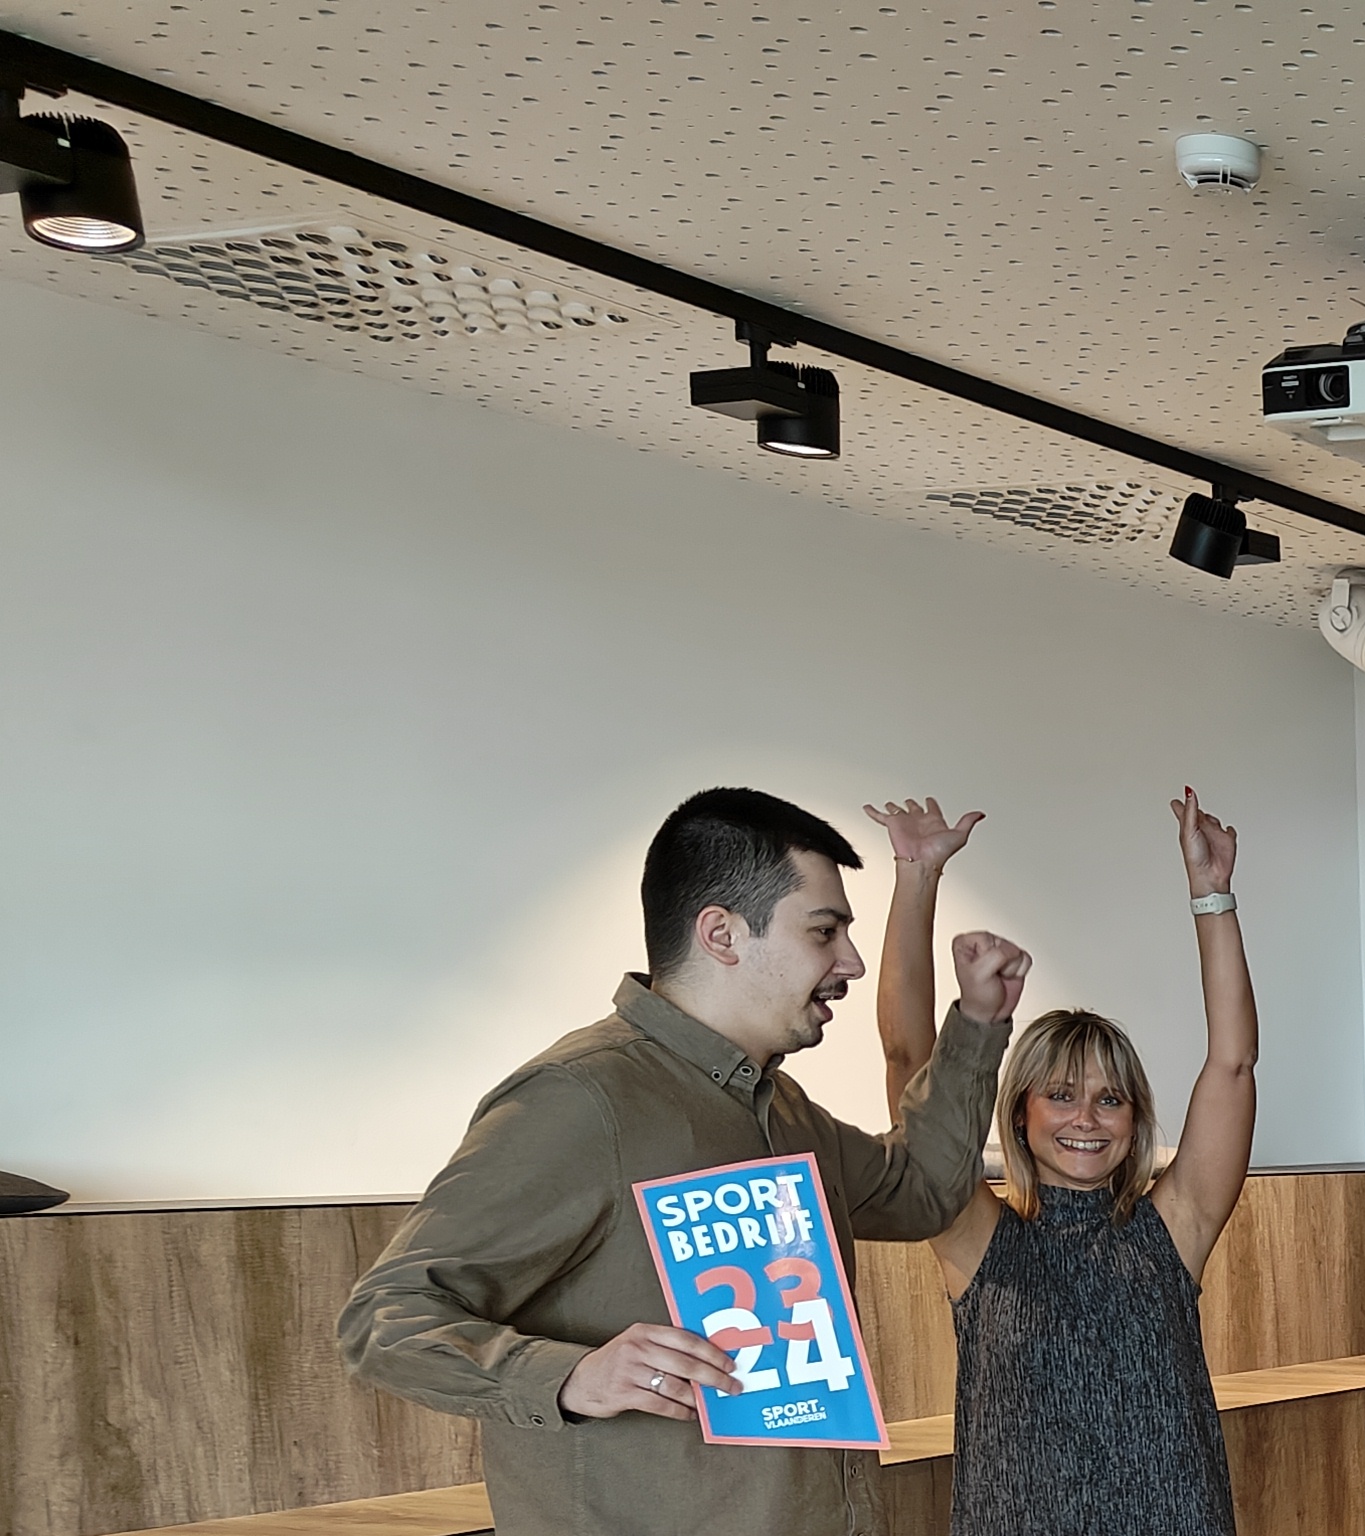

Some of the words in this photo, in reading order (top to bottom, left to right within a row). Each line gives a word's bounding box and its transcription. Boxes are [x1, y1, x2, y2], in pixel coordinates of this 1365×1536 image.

[656, 1173, 804, 1227] SPORT
[667, 1209, 814, 1263] BEDRIJF
[694, 1257, 834, 1351] 23
[702, 1298, 856, 1398] 24
[761, 1398, 826, 1421] SPORT.
[764, 1411, 827, 1430] VLAANDEREN
